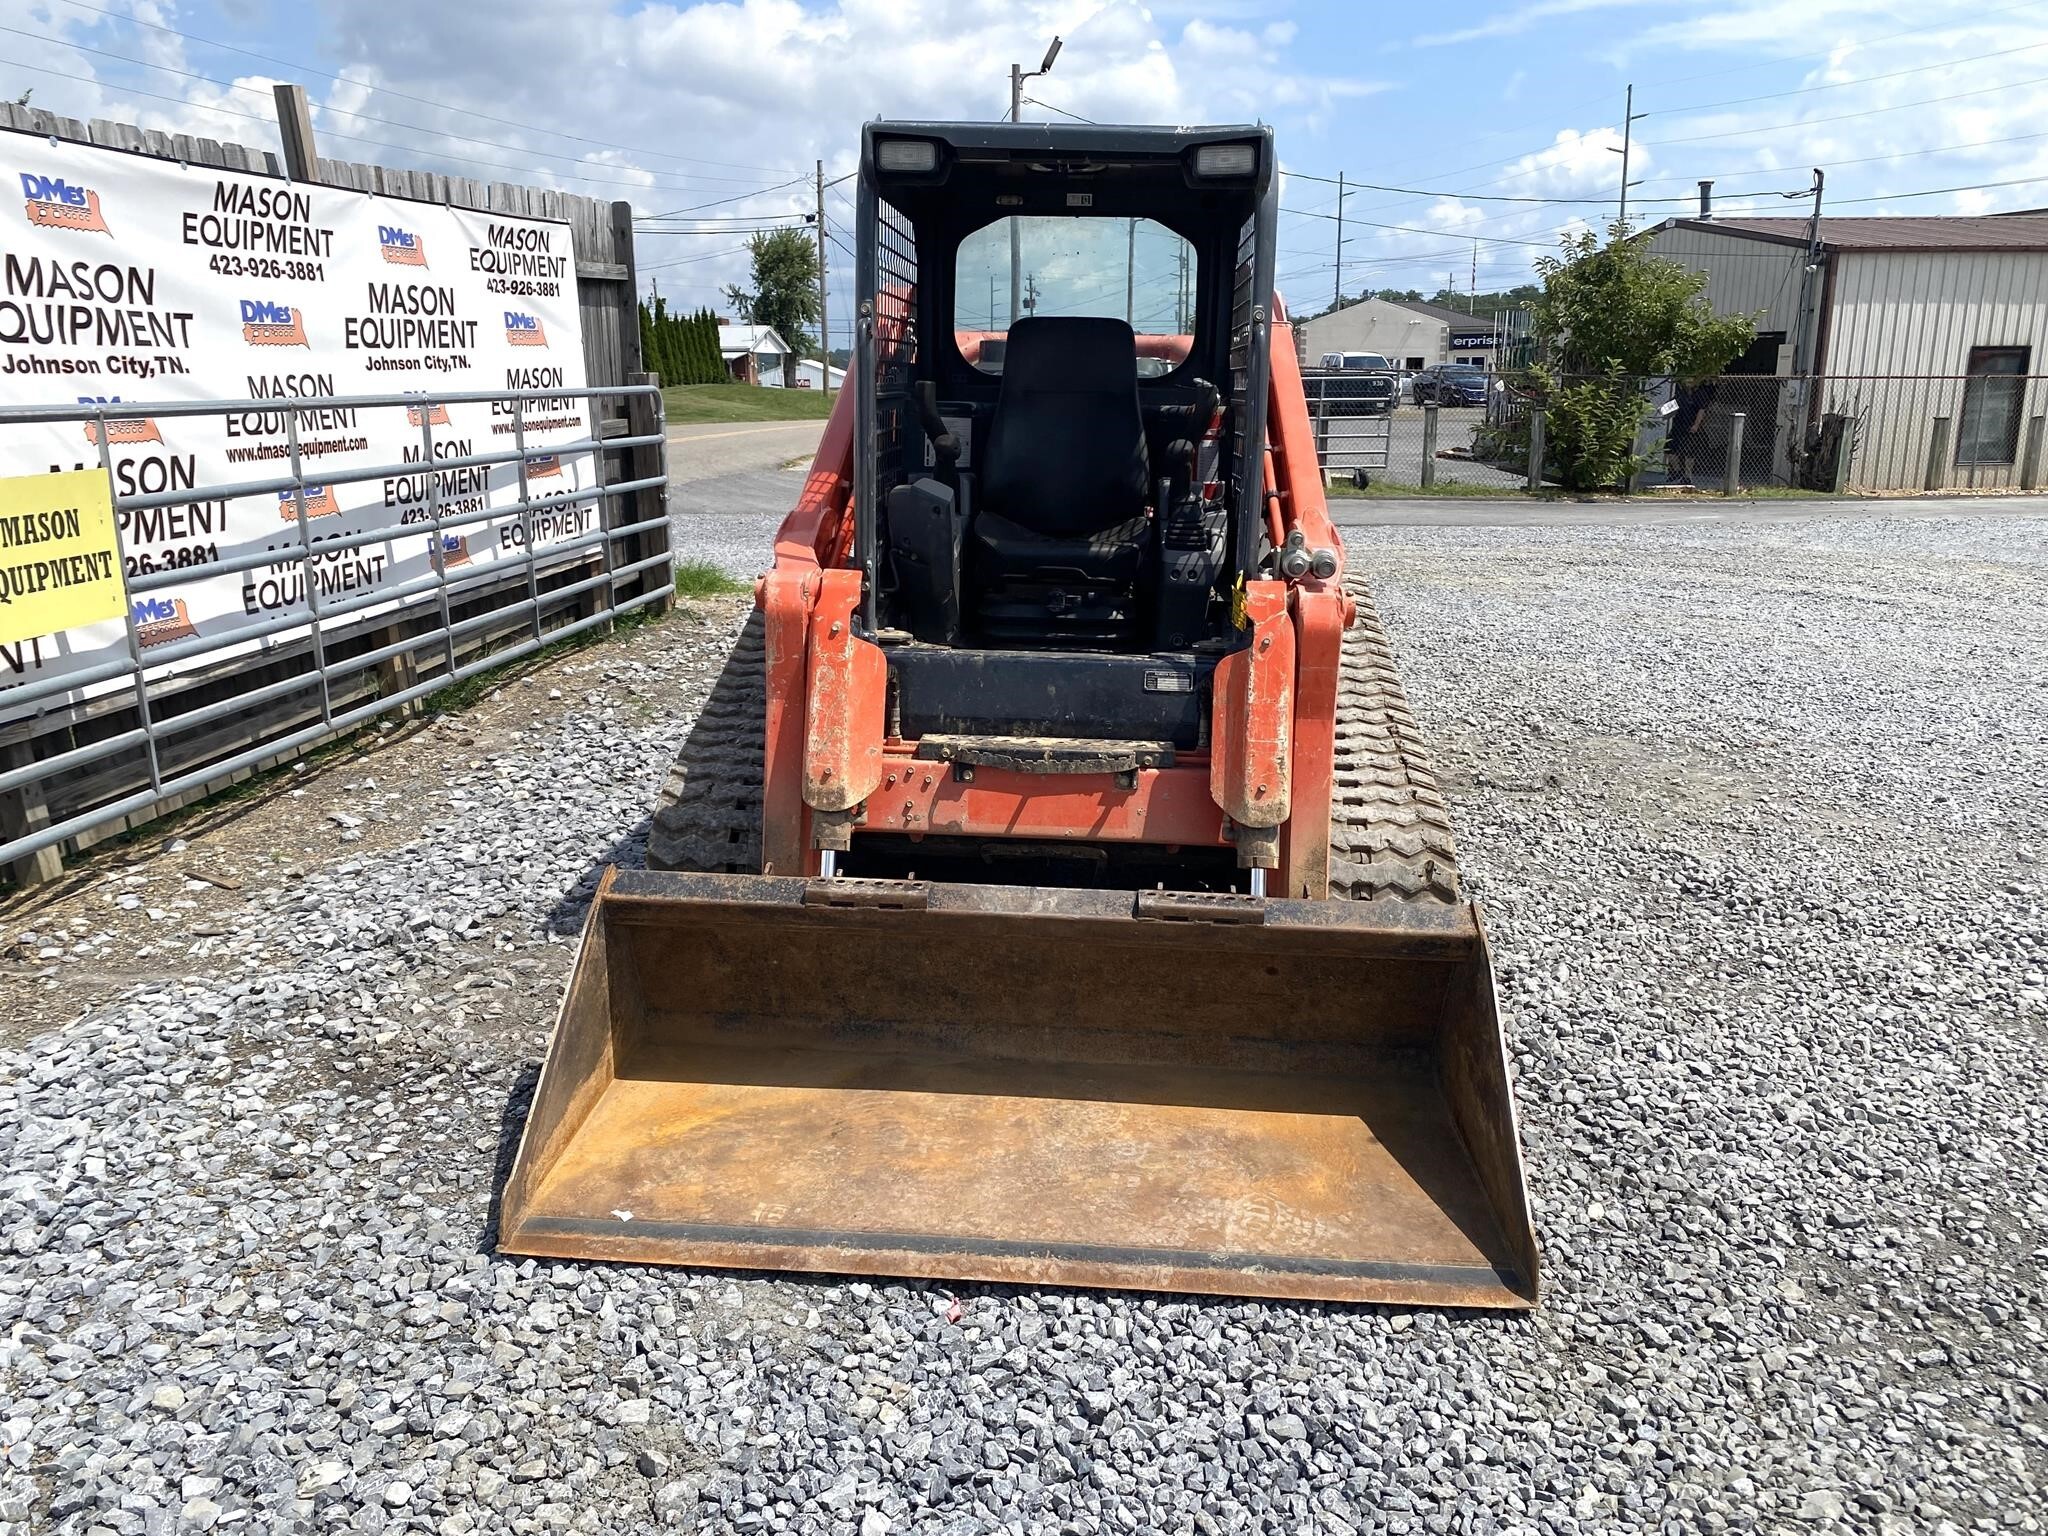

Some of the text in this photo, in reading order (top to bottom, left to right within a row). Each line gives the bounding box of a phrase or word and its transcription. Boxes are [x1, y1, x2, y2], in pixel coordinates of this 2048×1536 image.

[213, 181, 310, 223] MASON
[183, 212, 334, 258] EQUIPMENT
[488, 223, 550, 253] MASON
[209, 254, 325, 282] 423-926-3881
[469, 247, 567, 279] EQUIPMENT
[5, 254, 154, 306] MASON
[486, 278, 560, 297] 423-926-3881
[368, 282, 455, 316] MASON
[0, 301, 194, 349] QUIPMENT
[345, 317, 478, 349] EQUIPMENT
[1453, 335, 1503, 347] erprise
[2, 354, 101, 375] Johnson
[365, 356, 421, 371] Johnson
[247, 374, 334, 399] MASON
[506, 367, 563, 390] MASON
[226, 408, 357, 437] EQUIMENT
[490, 416, 582, 435] www.dasonequipment.com
[226, 436, 368, 463] www.dmasoequipment.com
[403, 439, 472, 464] MSON
[401, 497, 484, 525] 423-26-3881
[0, 508, 80, 548] MASON
[126, 542, 220, 578] 26-3881
[268, 529, 362, 575] MSON
[0, 551, 112, 604] QUIPMENT
